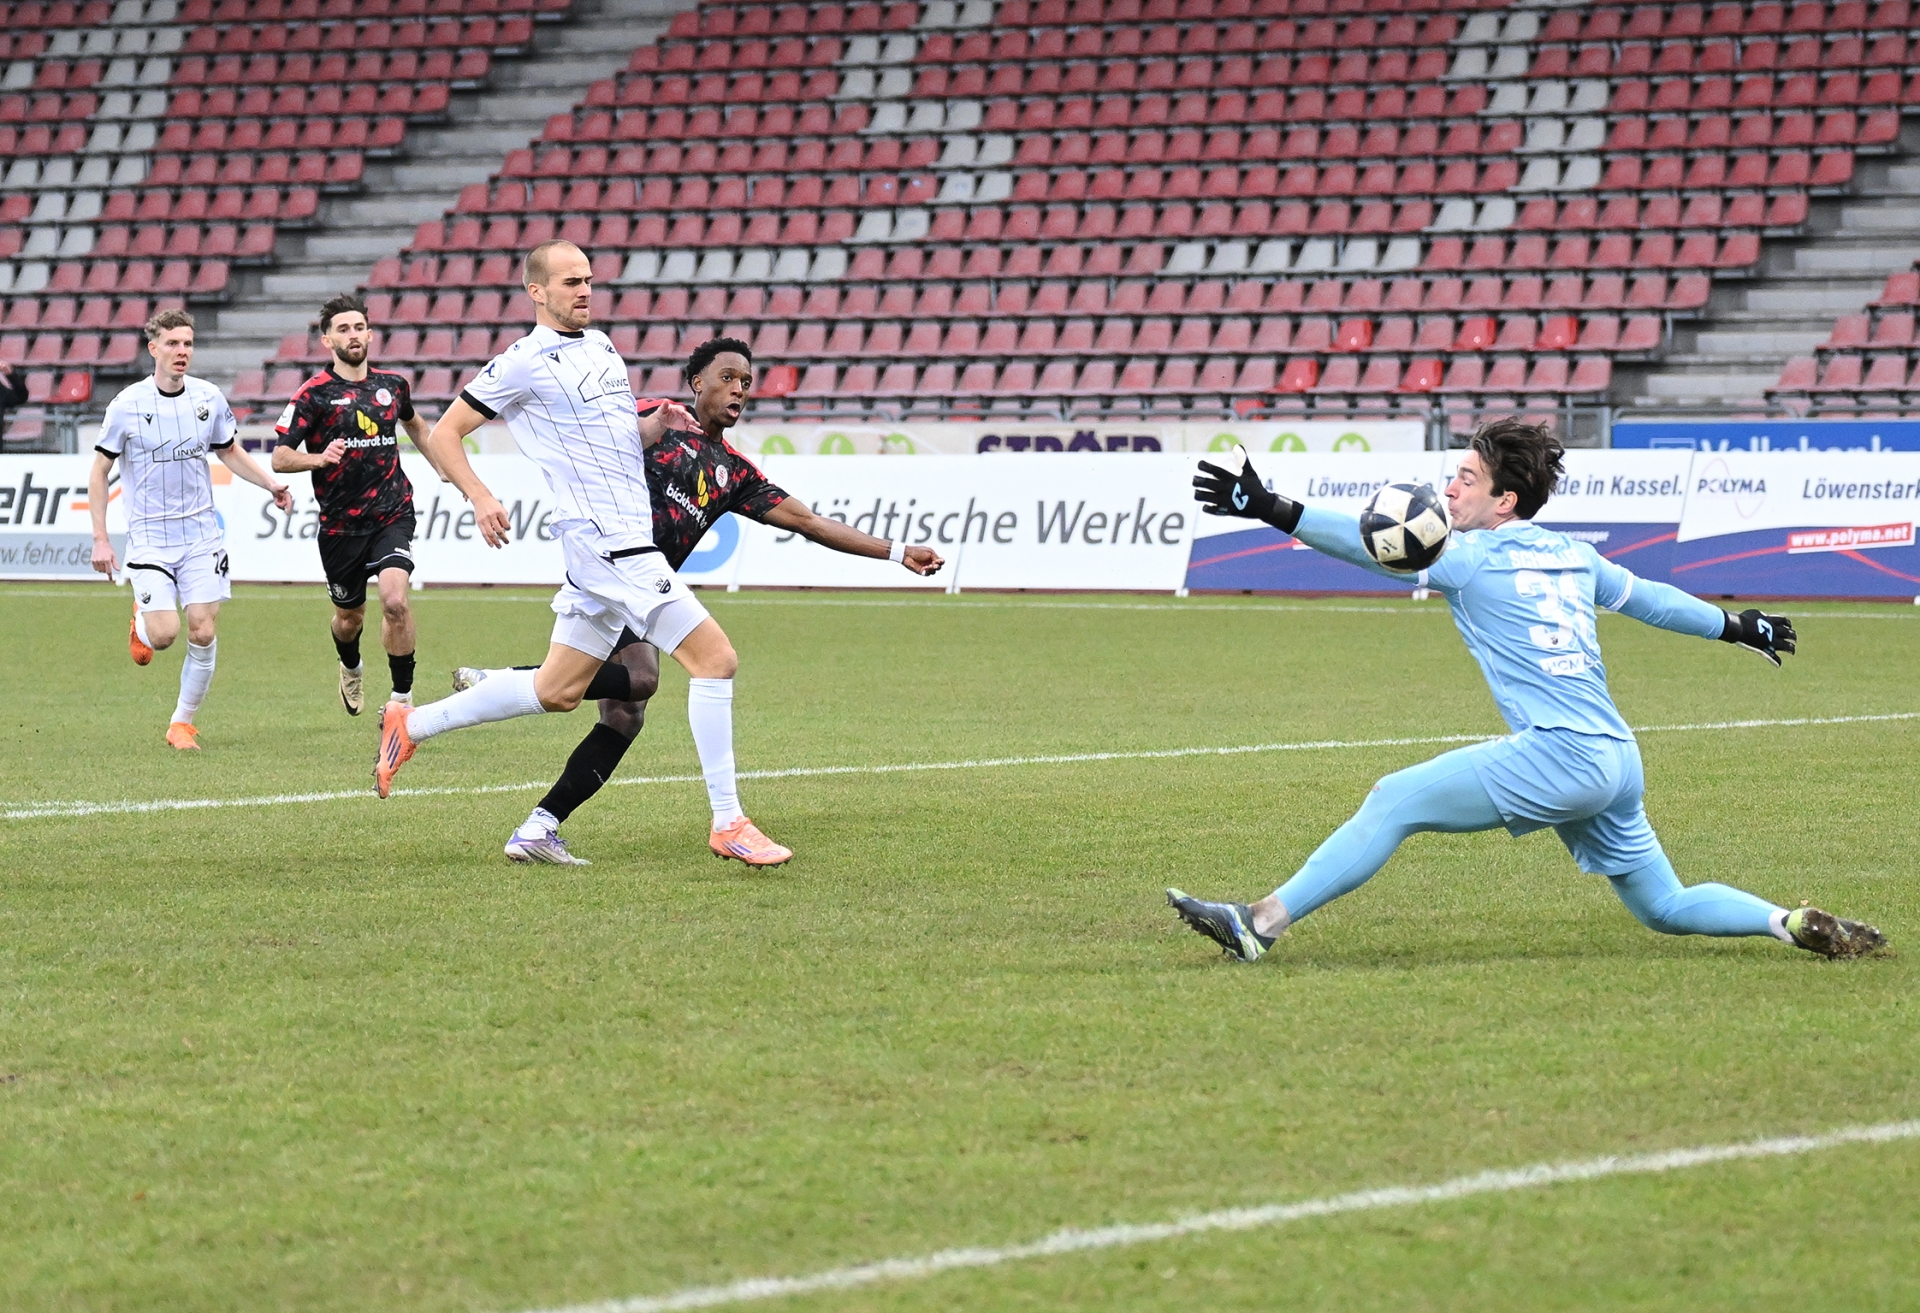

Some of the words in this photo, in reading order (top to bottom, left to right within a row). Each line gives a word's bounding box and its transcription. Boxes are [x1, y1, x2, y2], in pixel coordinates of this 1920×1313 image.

[1586, 475, 1605, 495] in
[1610, 475, 1683, 496] Kassel.
[1697, 479, 1767, 493] POLYMA
[1037, 497, 1185, 545] Werke
[1791, 525, 1908, 547] www.polyma.net
[0, 541, 92, 566] w.fehr.de
